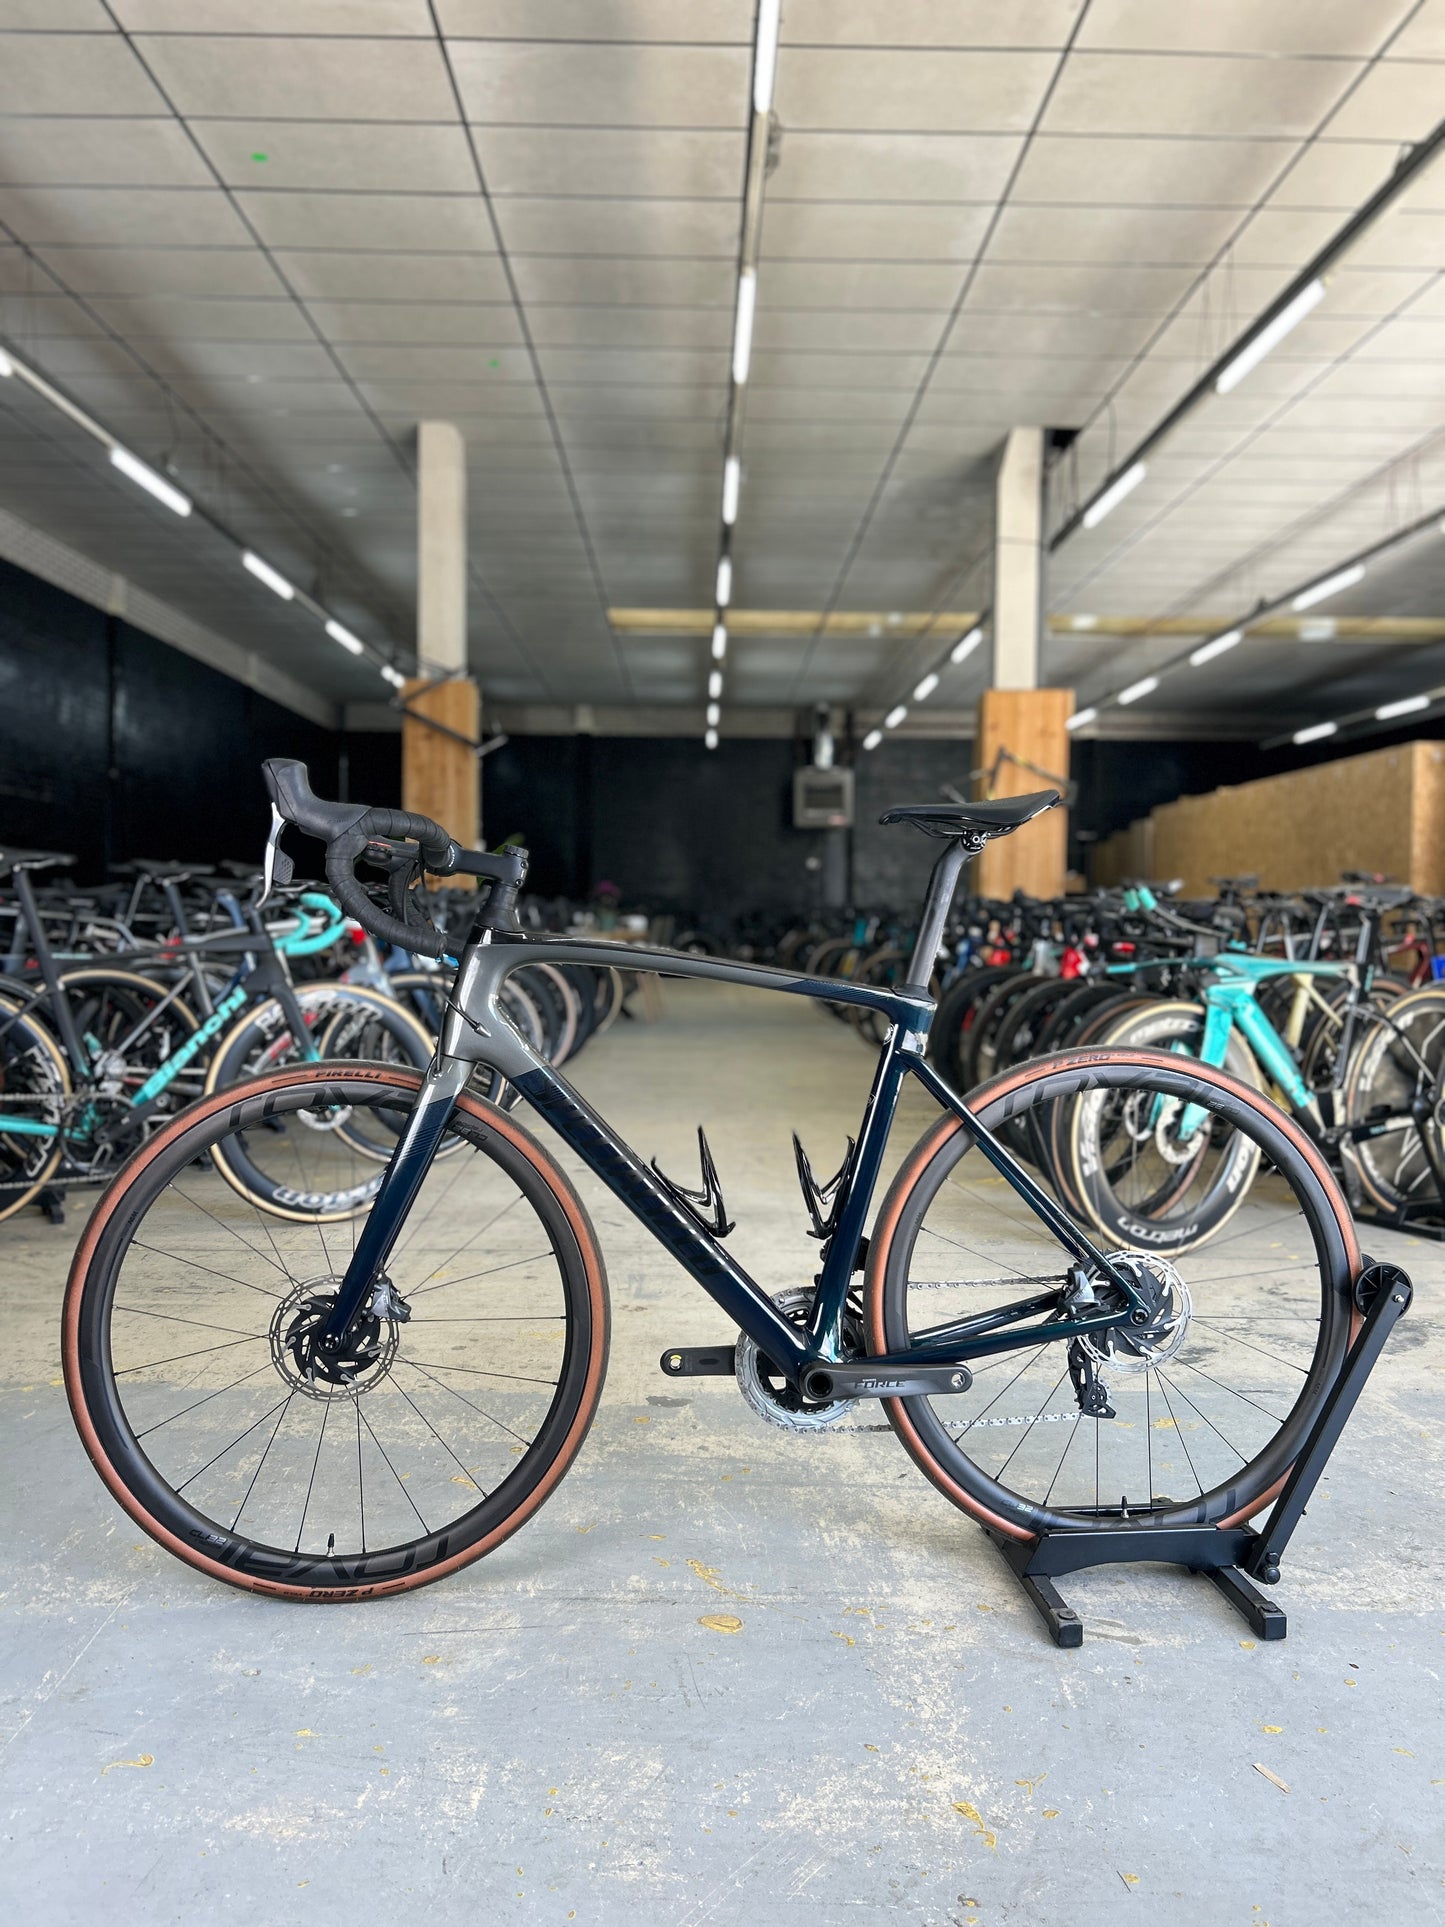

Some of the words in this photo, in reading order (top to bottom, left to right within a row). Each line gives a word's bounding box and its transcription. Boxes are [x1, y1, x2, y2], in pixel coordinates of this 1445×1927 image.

[1052, 1059, 1064, 1070] P
[1066, 1052, 1112, 1066] ZERO
[315, 1070, 382, 1080] PIRELLI
[854, 1380, 906, 1389] FORCE
[1016, 1503, 1034, 1513] 32
[205, 1533, 228, 1545] 32
[309, 1588, 360, 1598] ZERO
[361, 1587, 375, 1596] P
